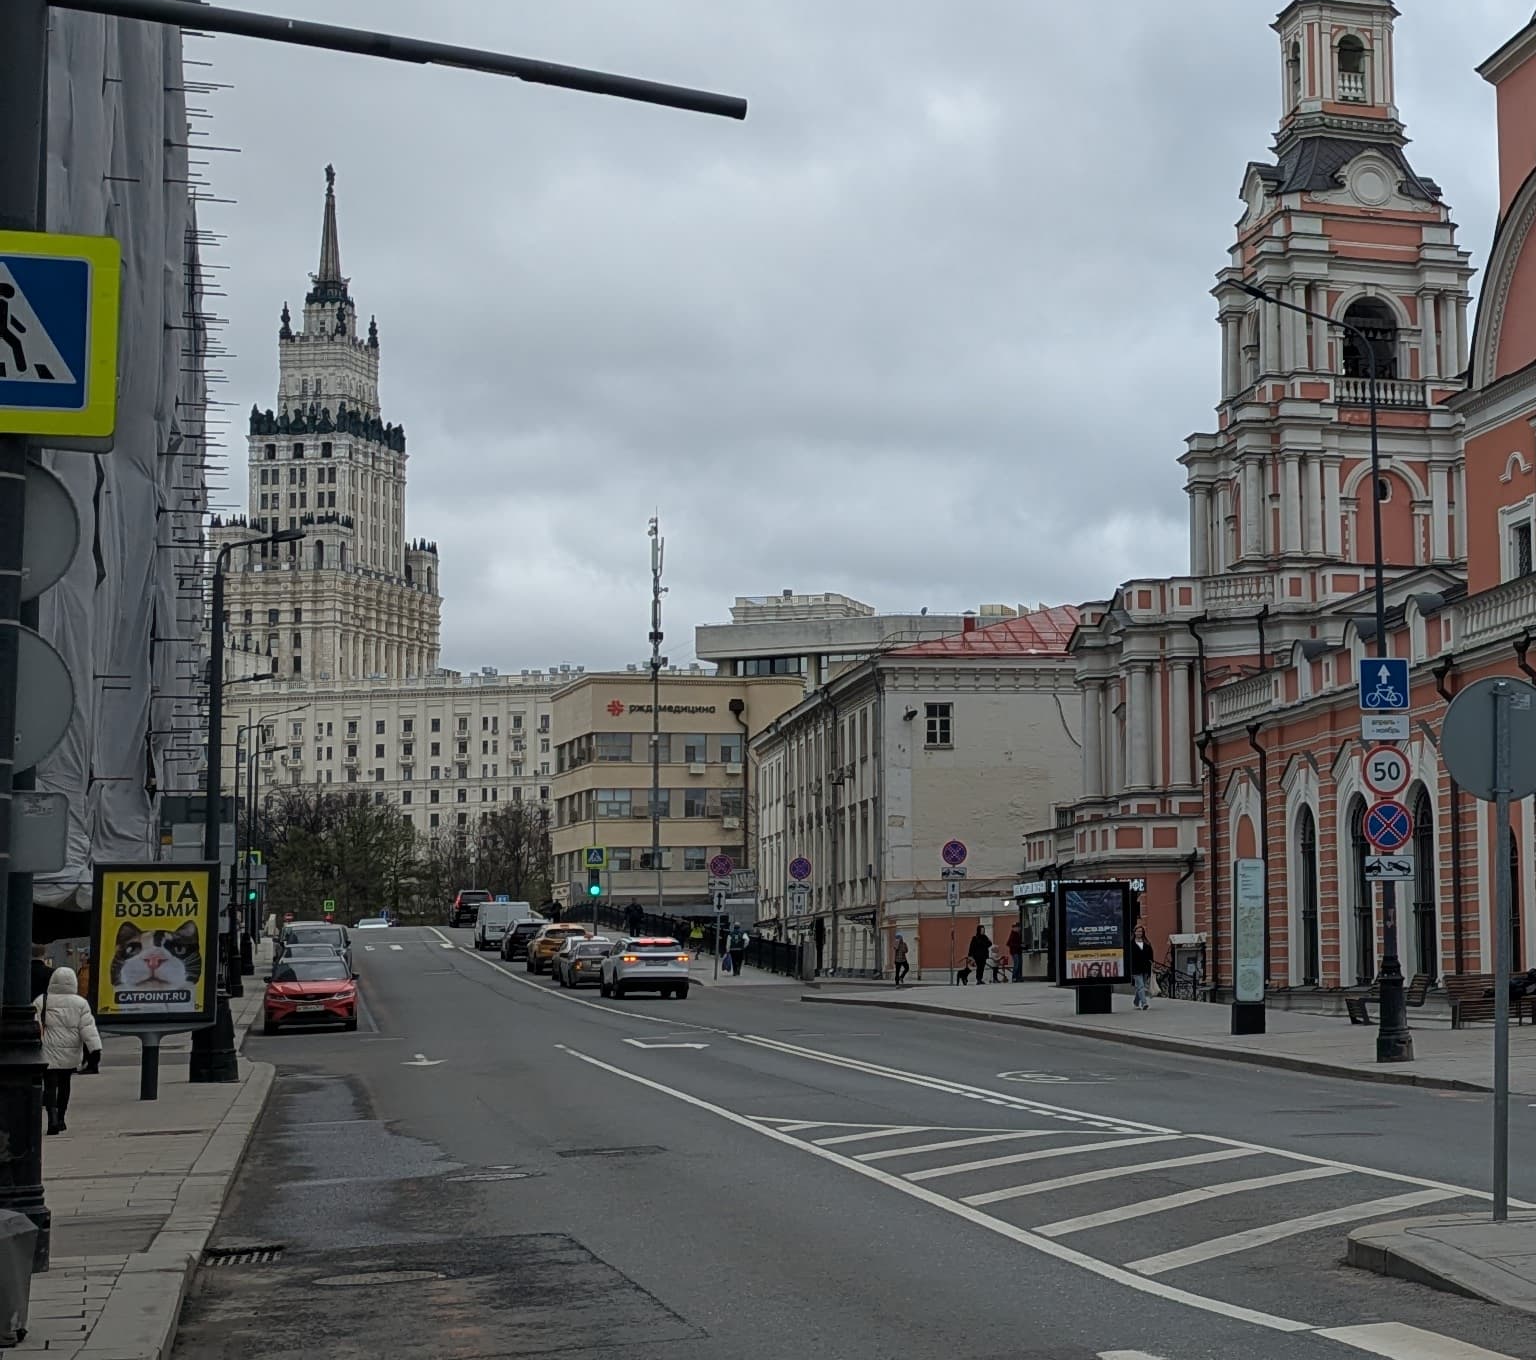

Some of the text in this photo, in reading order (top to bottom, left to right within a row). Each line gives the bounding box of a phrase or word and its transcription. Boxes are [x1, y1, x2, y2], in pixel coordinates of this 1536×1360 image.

[1374, 761, 1401, 782] 50
[117, 880, 199, 903] КОТА
[115, 902, 198, 918] ВОЗЬМИ
[118, 991, 187, 1003] CATPOINT.RU
